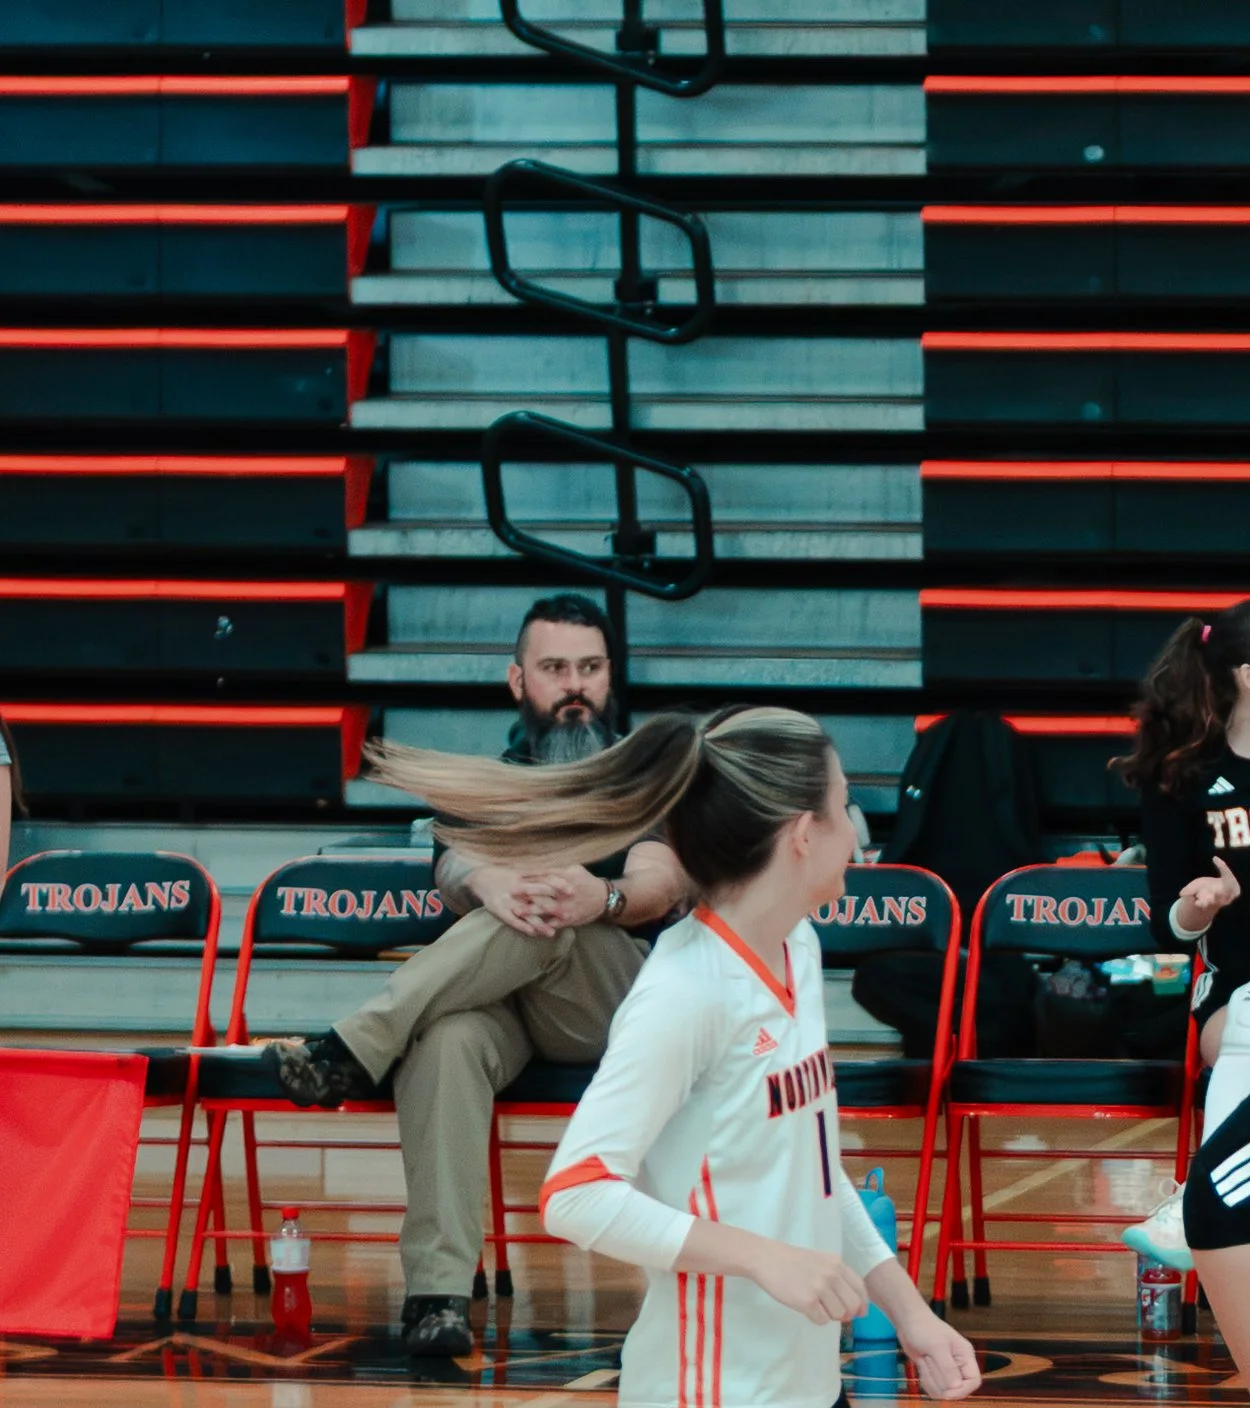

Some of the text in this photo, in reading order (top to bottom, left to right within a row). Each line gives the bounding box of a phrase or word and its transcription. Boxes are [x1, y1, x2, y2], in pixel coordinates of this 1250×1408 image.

[20, 880, 191, 914] TROJANS
[276, 886, 444, 919] TROJANS
[808, 895, 928, 926] OJANS
[815, 1110, 832, 1198] 1
